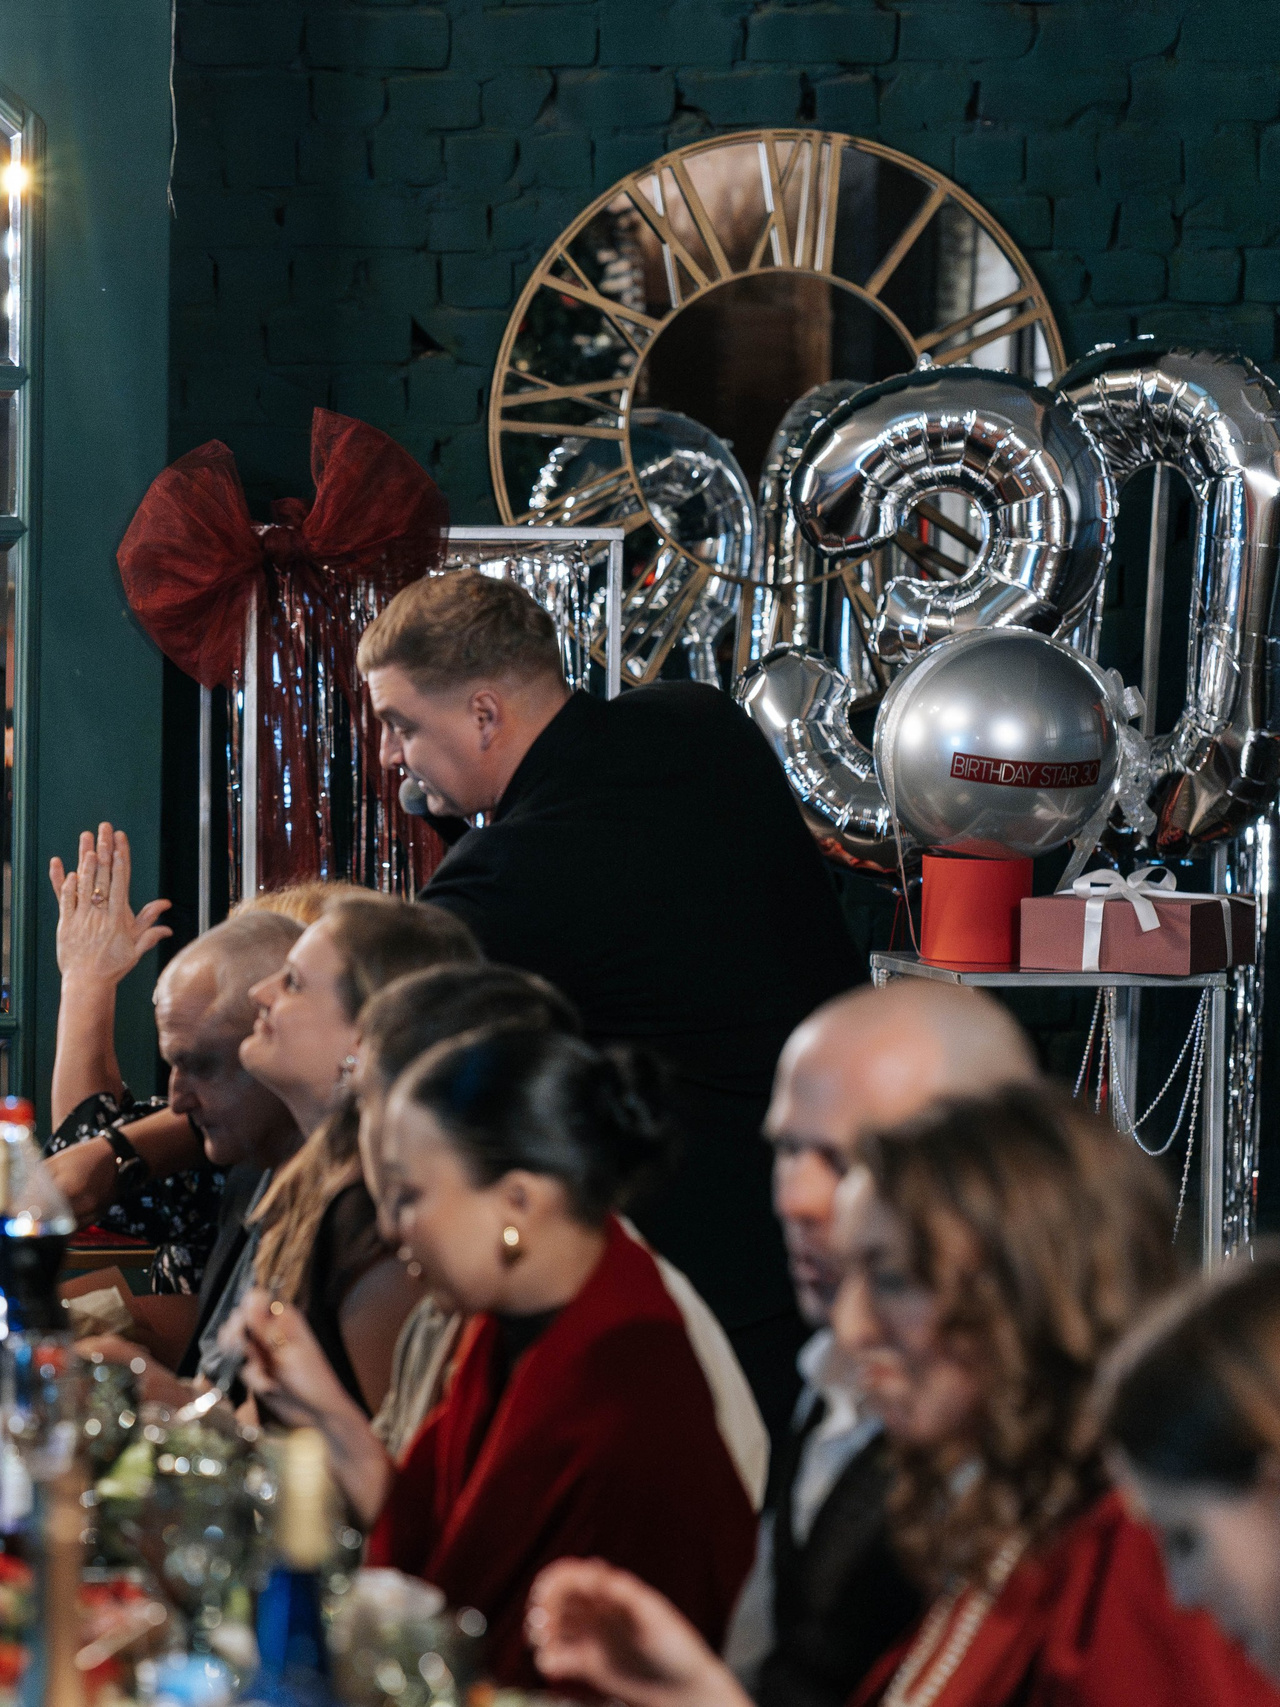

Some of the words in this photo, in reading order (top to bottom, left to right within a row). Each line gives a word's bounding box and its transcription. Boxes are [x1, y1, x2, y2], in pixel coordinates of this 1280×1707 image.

[952, 755, 1037, 784] BIRTHDAY
[1039, 765, 1078, 786] STAR
[1080, 763, 1098, 784] 30
